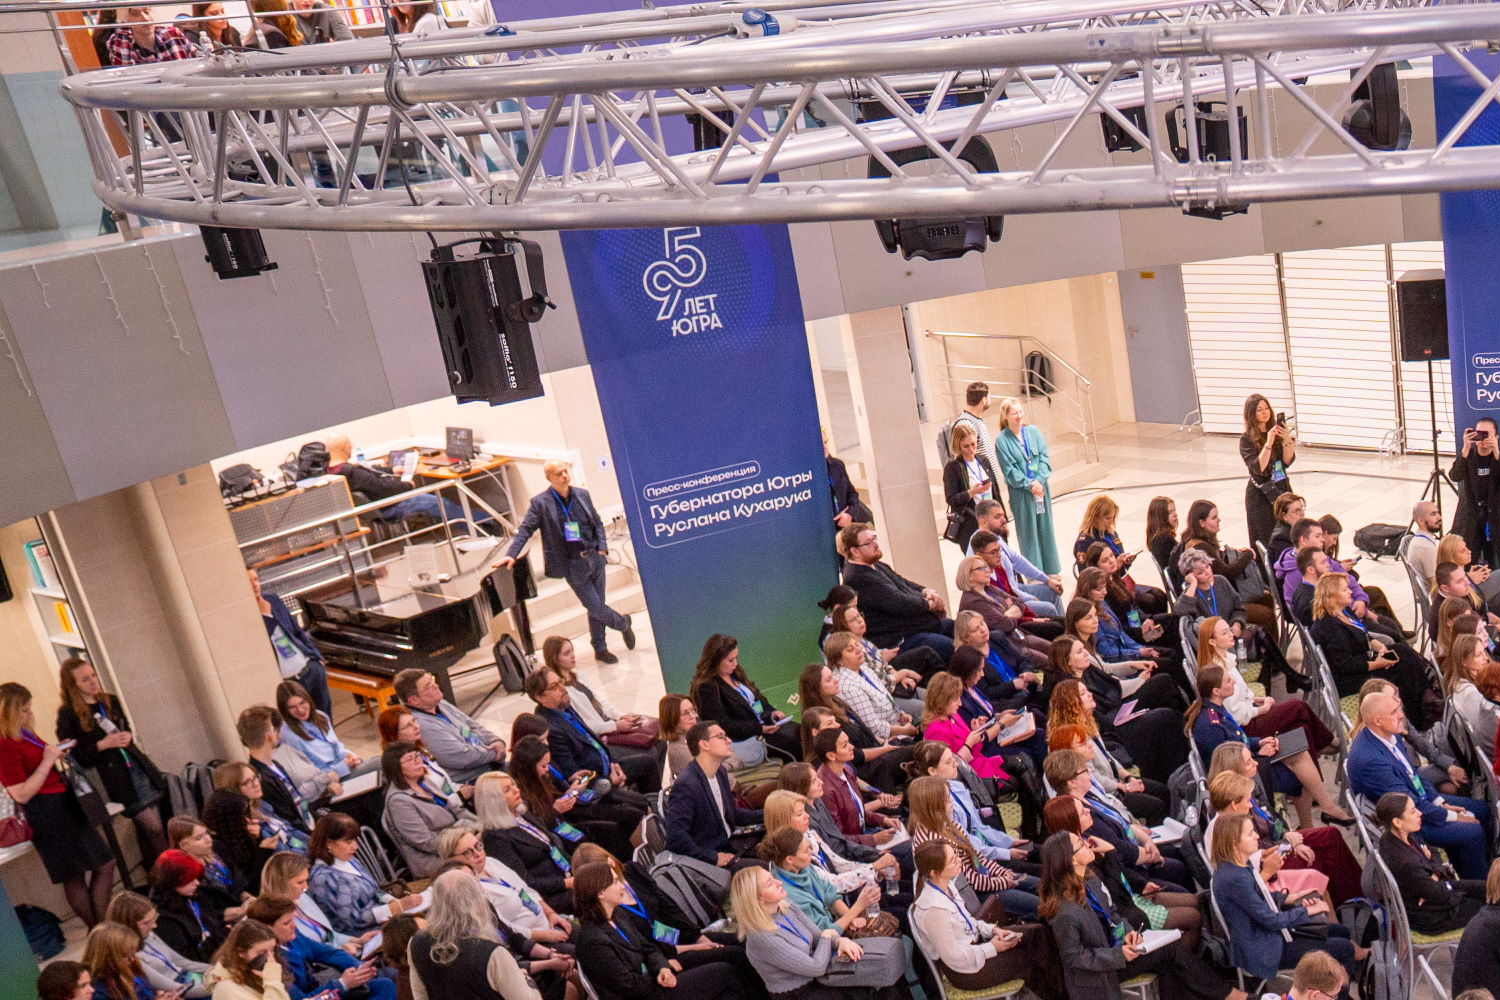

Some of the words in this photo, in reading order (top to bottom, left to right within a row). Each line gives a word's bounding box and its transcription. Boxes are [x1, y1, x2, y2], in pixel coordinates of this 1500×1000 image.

[684, 294, 717, 315] ЛЕТ
[671, 313, 722, 336] ЮГРА
[647, 465, 756, 497] Пресс-конференция
[650, 484, 764, 519] Губернатора
[767, 470, 812, 491] Югры
[654, 510, 730, 537] Руслана
[734, 489, 812, 518] Кухарука
